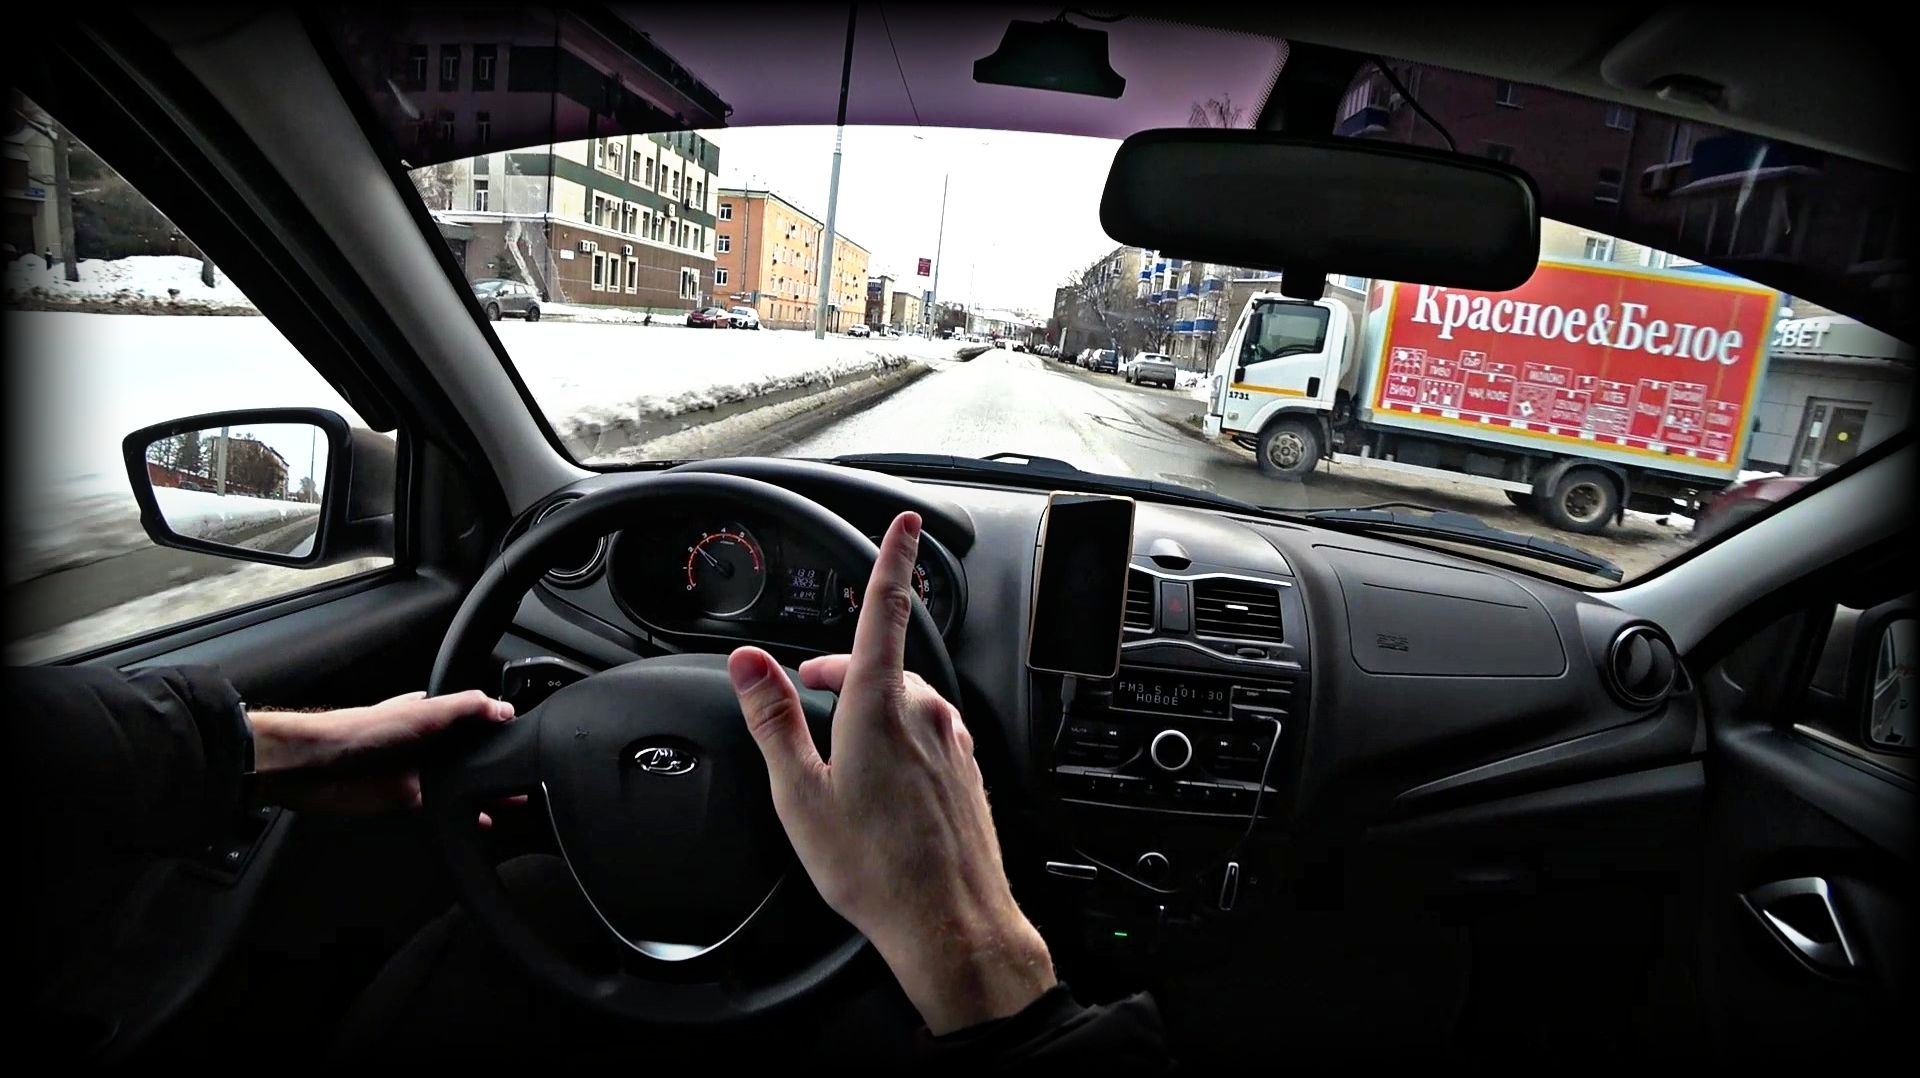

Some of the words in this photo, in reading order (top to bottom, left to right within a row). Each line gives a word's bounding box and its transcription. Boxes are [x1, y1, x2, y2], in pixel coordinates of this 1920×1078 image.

[1411, 284, 1743, 365] Красное&Белое
[1228, 391, 1250, 401] 1731
[1119, 681, 1145, 694] FM3
